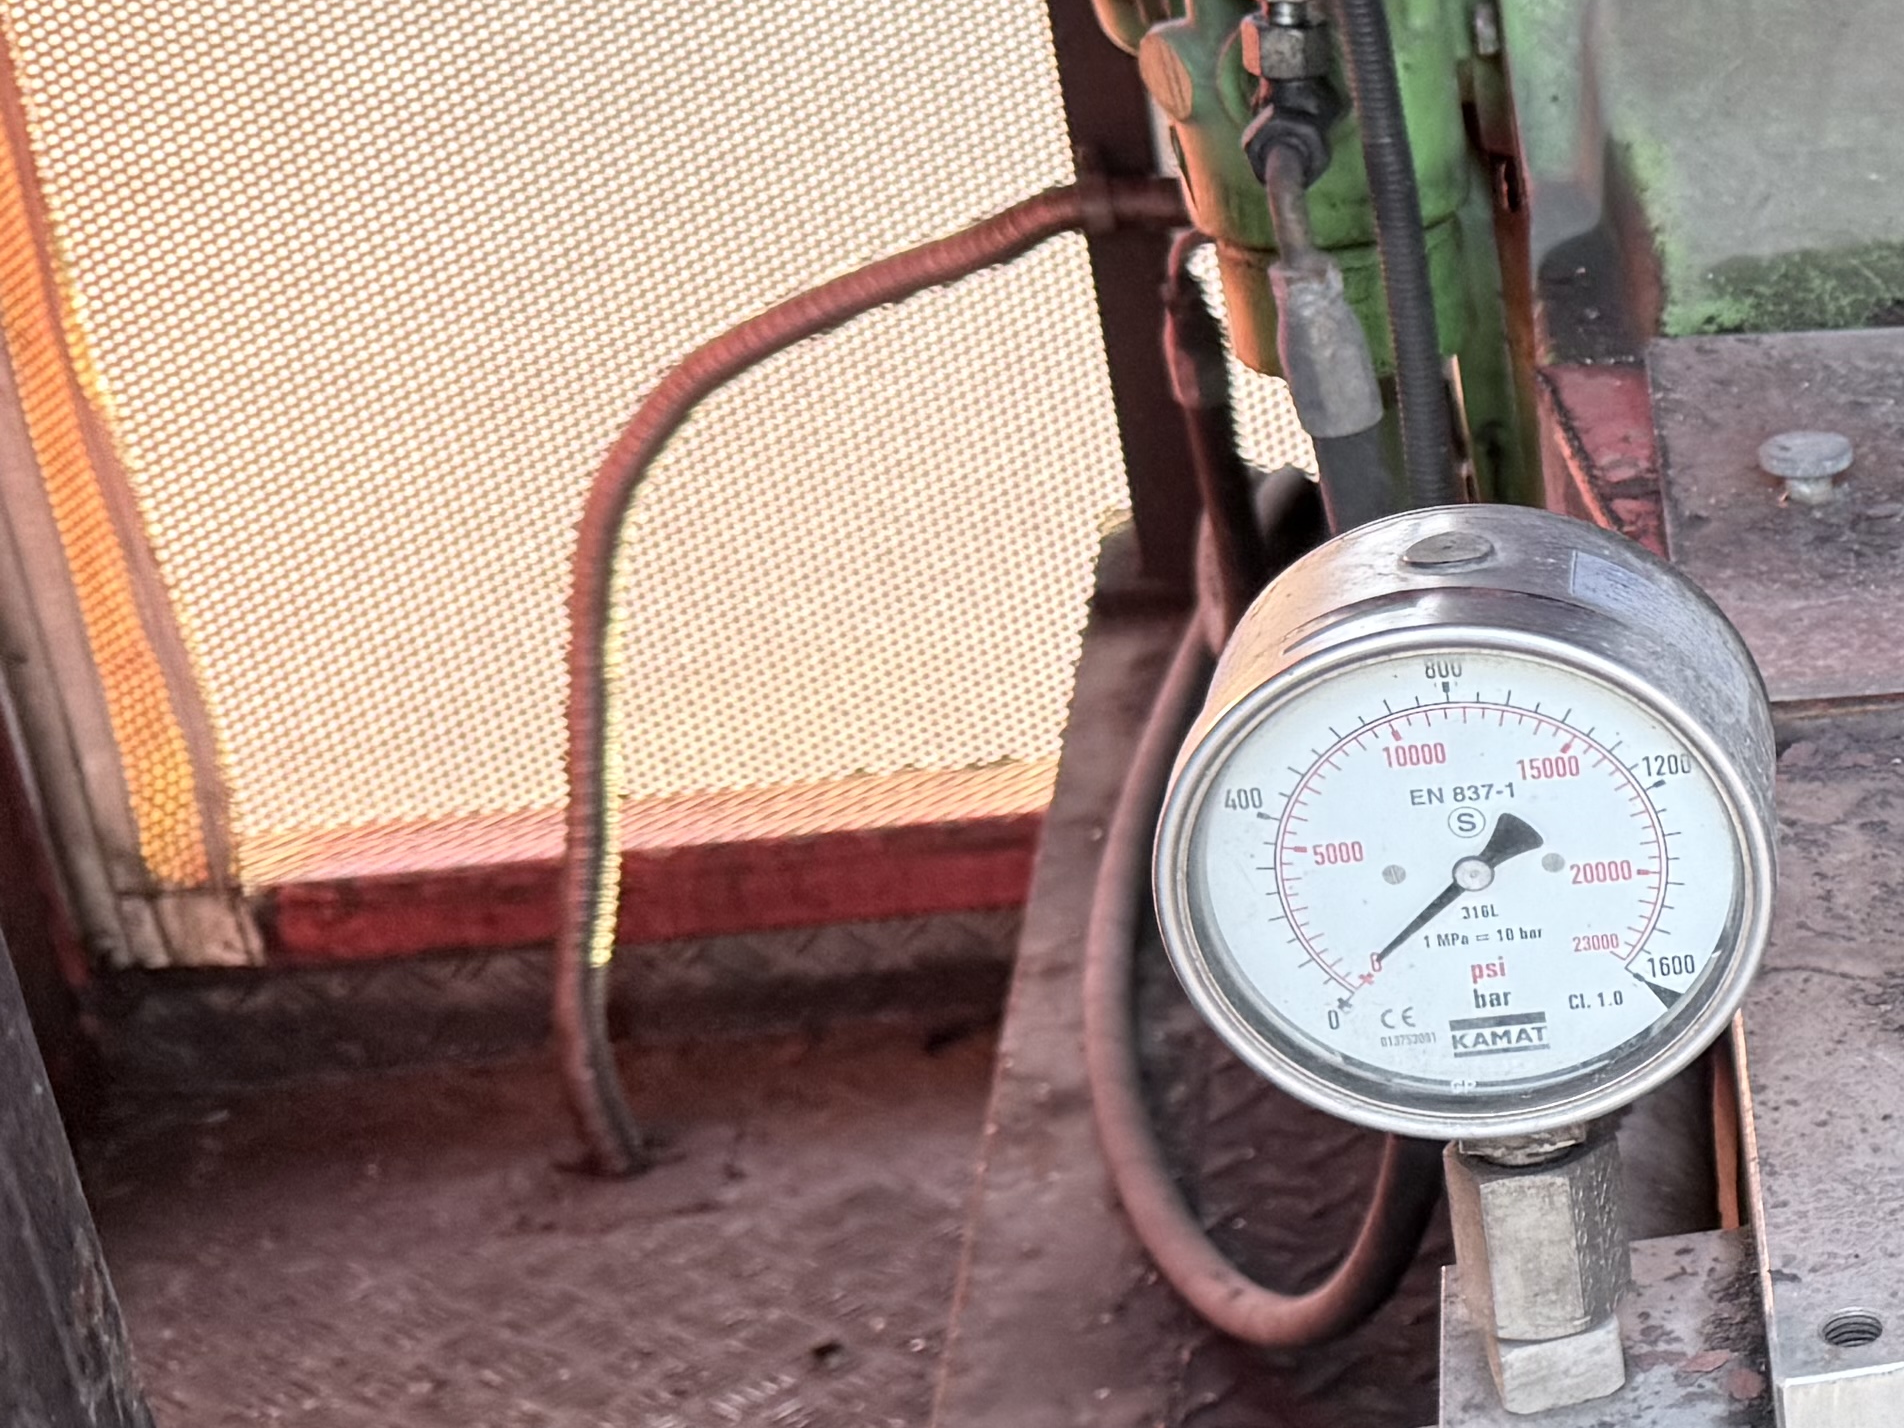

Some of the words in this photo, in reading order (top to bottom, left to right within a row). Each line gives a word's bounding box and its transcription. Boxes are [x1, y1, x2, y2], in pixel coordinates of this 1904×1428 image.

[1425, 659, 1463, 679] 800
[1382, 742, 1446, 768] 10000
[1642, 753, 1692, 777] 1200
[1516, 755, 1580, 781] 15000
[1224, 787, 1263, 811] 400
[1409, 787, 1445, 806] EN
[1452, 782, 1515, 803] 837-1
[1456, 812, 1477, 833] S
[1312, 841, 1364, 865] 5000
[1569, 860, 1633, 885] 20000
[1460, 904, 1499, 920] 316L
[1423, 935, 1431, 948] 1
[1436, 932, 1470, 948] MPa
[1497, 928, 1514, 943] 10
[1519, 927, 1543, 940] bar
[1572, 933, 1620, 953] 23000
[1471, 956, 1507, 985] psi
[1647, 954, 1696, 978] 1600
[1473, 988, 1512, 1009] bar
[1597, 990, 1624, 1007] 1.0
[1327, 1009, 1340, 1030] 0
[1451, 1025, 1548, 1050] KAMAT
